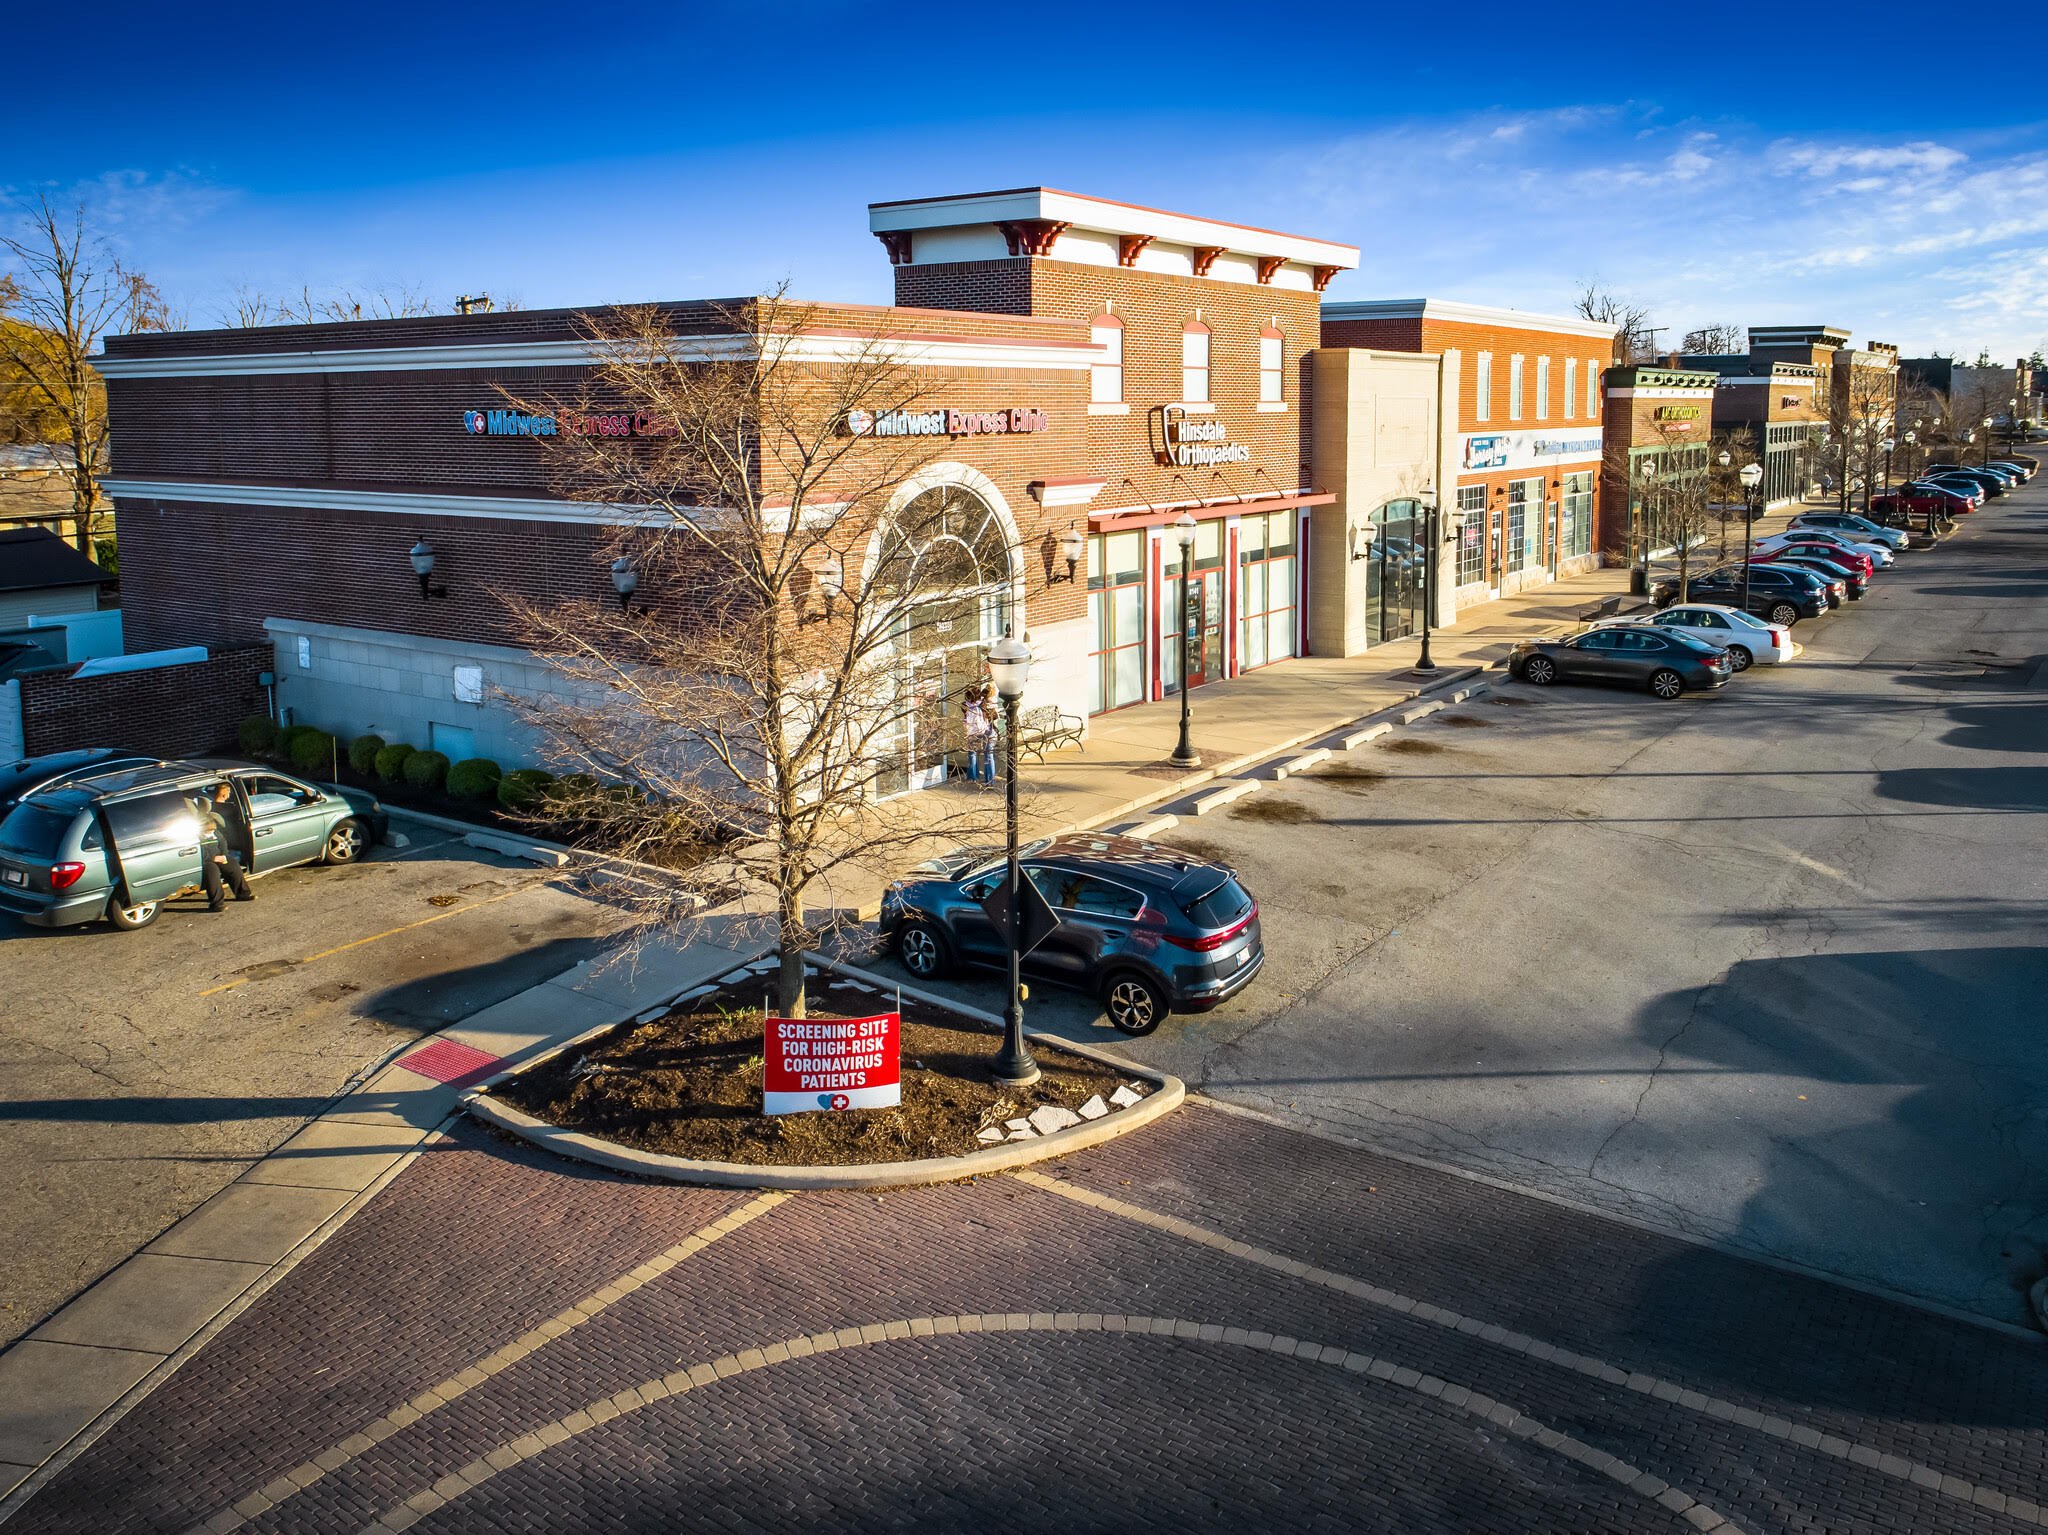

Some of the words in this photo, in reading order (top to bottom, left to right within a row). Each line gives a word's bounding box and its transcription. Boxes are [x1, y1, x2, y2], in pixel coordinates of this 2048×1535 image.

[487, 410, 557, 436] Midwest
[876, 410, 946, 436] Midwest
[949, 410, 1008, 438] Express
[1011, 408, 1049, 433] Clinic
[1178, 421, 1226, 442] Hinsdale
[1178, 441, 1249, 467] Orthopaedics
[777, 1023, 856, 1040] SCREENING
[859, 1019, 889, 1036] SITE
[782, 1041, 809, 1056] FOR
[812, 1036, 885, 1056] HIGH-RISK
[783, 1053, 883, 1072] CORONAVIRUS
[801, 1071, 866, 1089] PATIENTS
